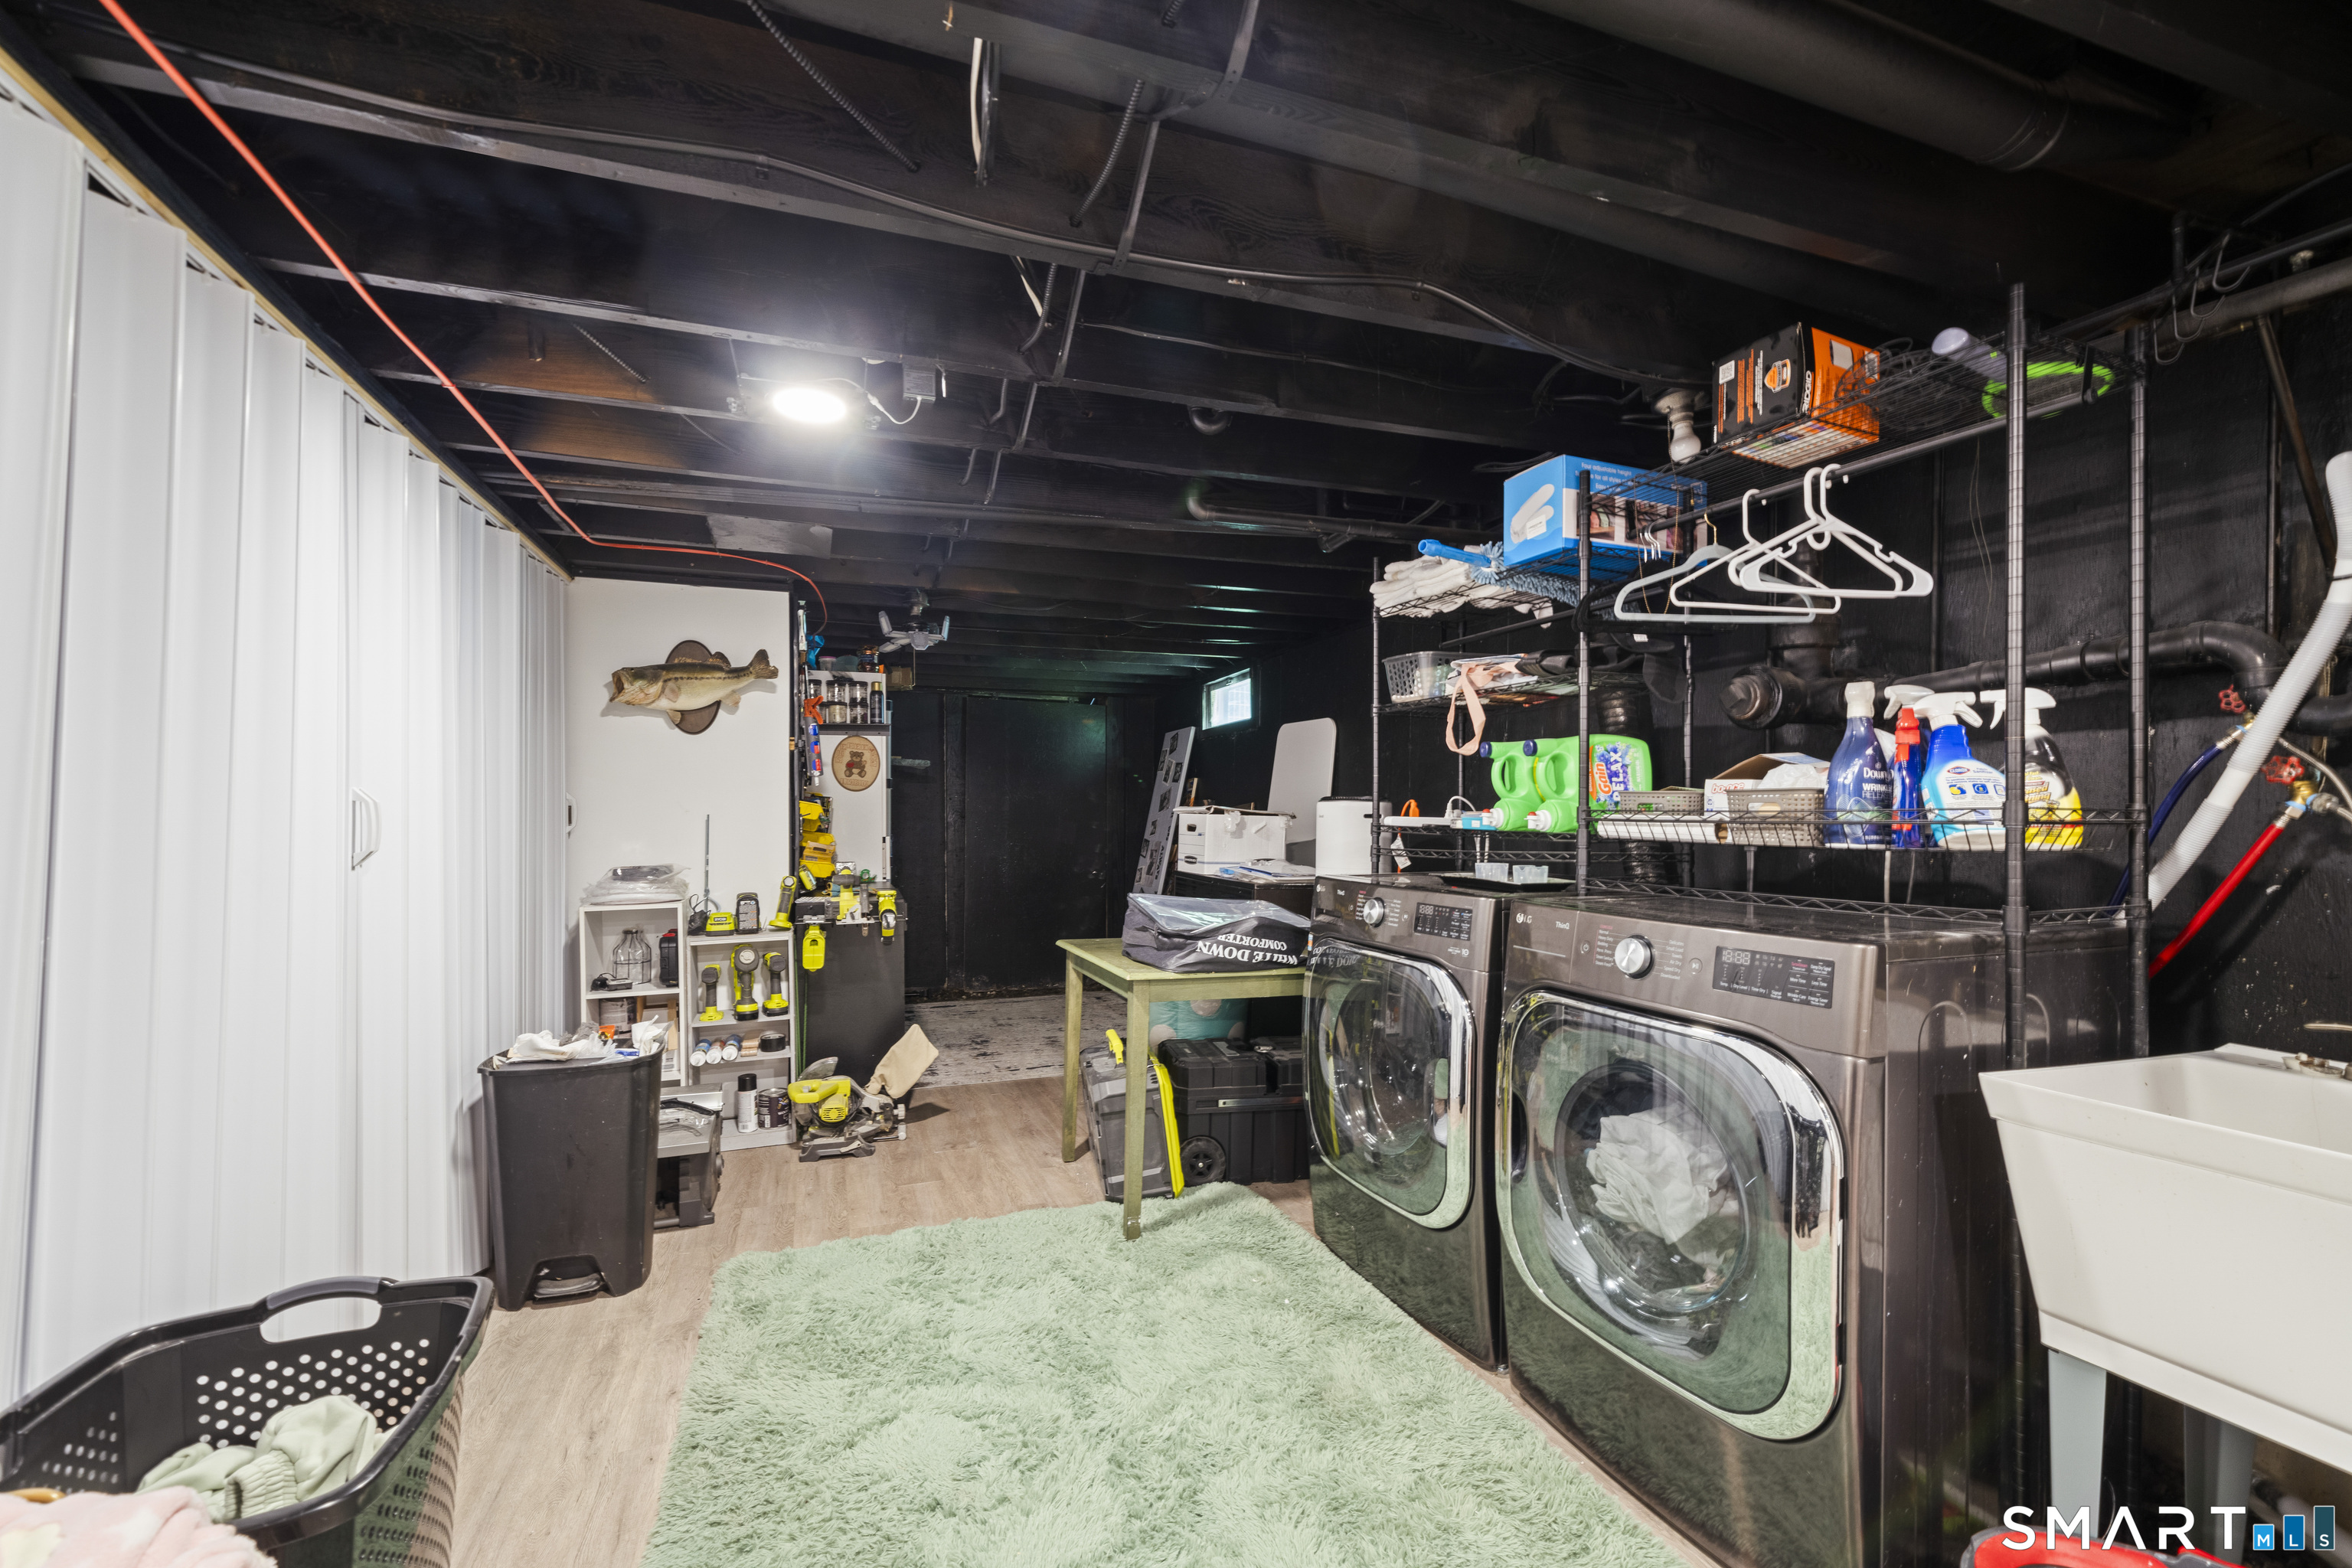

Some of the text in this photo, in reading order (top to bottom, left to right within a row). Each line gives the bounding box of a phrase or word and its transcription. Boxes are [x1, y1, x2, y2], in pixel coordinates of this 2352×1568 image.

[1802, 371, 1812, 413] RIDGID
[1596, 763, 1612, 795] Gain
[1555, 921, 1570, 929] ThinQ
[1196, 940, 1250, 962] DOWN
[1217, 933, 1287, 951] COMFORTER
[1252, 951, 1298, 965] WHITE
